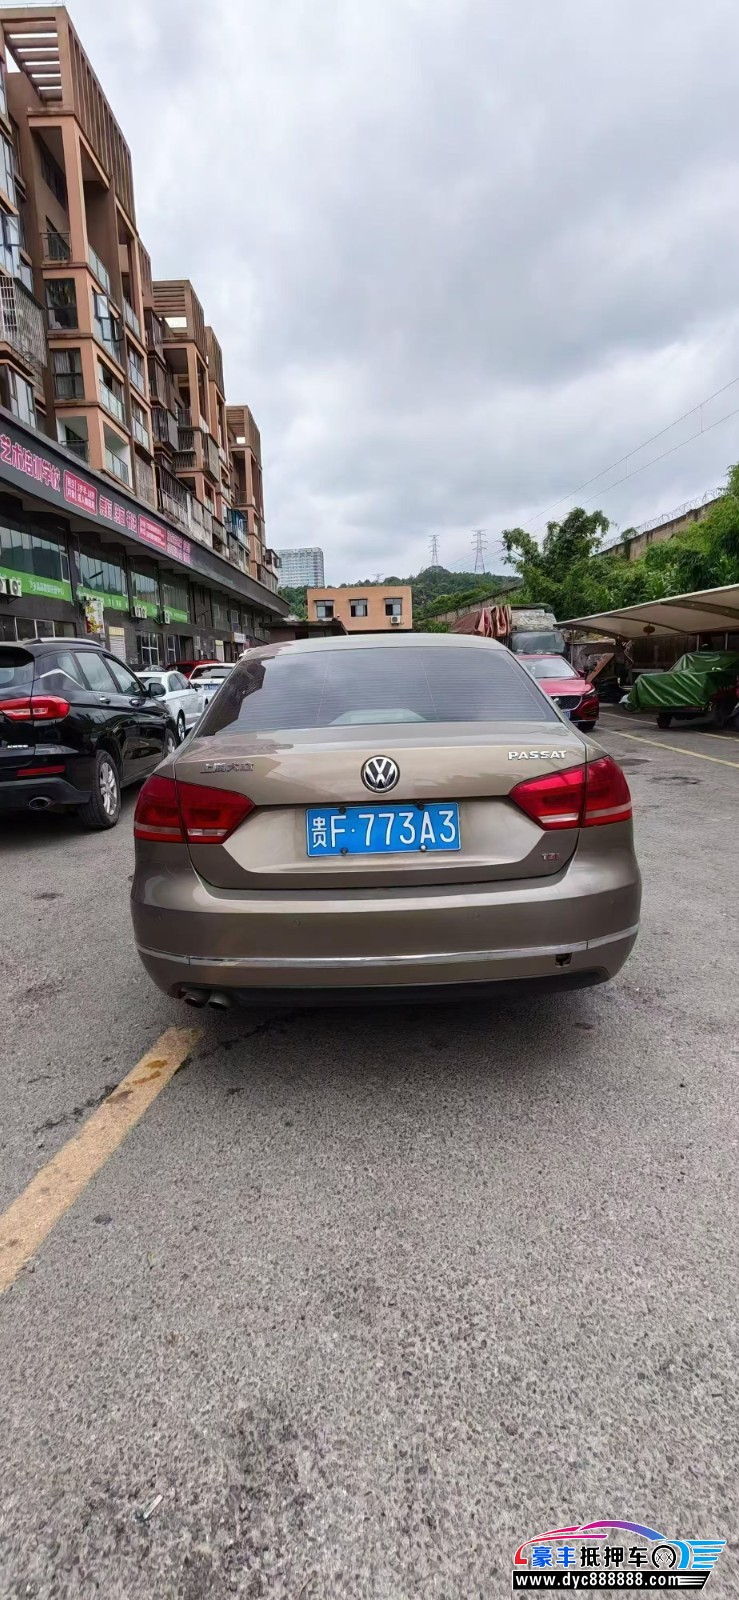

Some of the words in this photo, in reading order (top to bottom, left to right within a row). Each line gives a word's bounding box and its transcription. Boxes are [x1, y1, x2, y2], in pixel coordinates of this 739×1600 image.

[0, 434, 60, 492] 艺术培训学校
[508, 750, 567, 760] PASSAT
